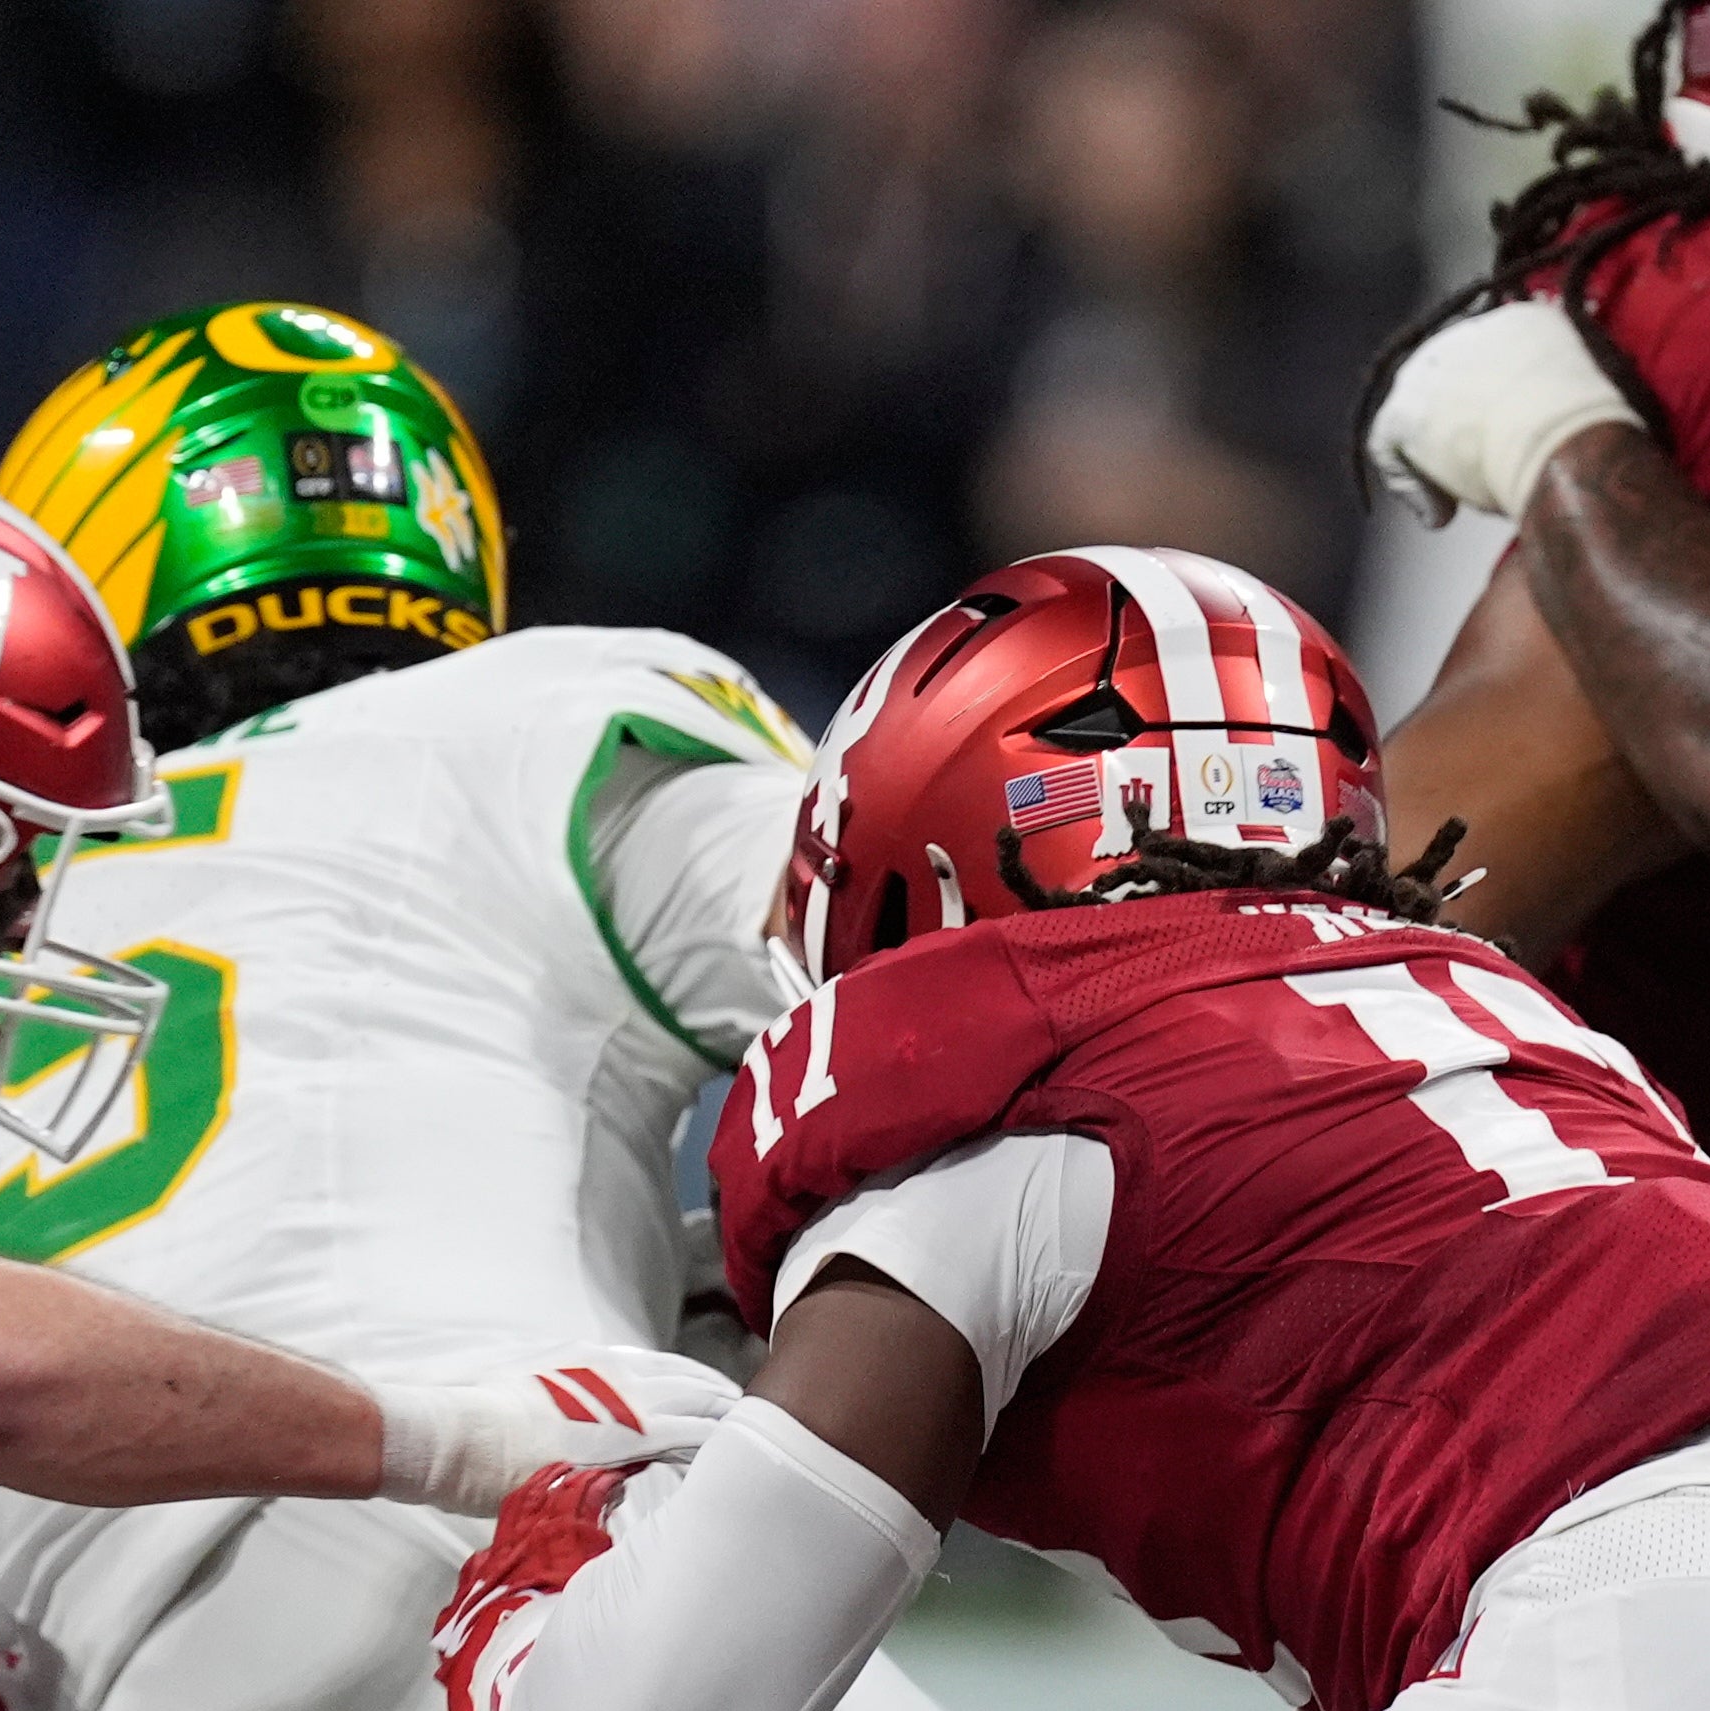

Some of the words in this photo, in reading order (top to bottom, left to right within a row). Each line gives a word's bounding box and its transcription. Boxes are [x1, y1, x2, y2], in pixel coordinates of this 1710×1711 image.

[187, 584, 492, 656] DUCKS
[1204, 801, 1236, 815] CFP
[741, 972, 842, 1163] 17
